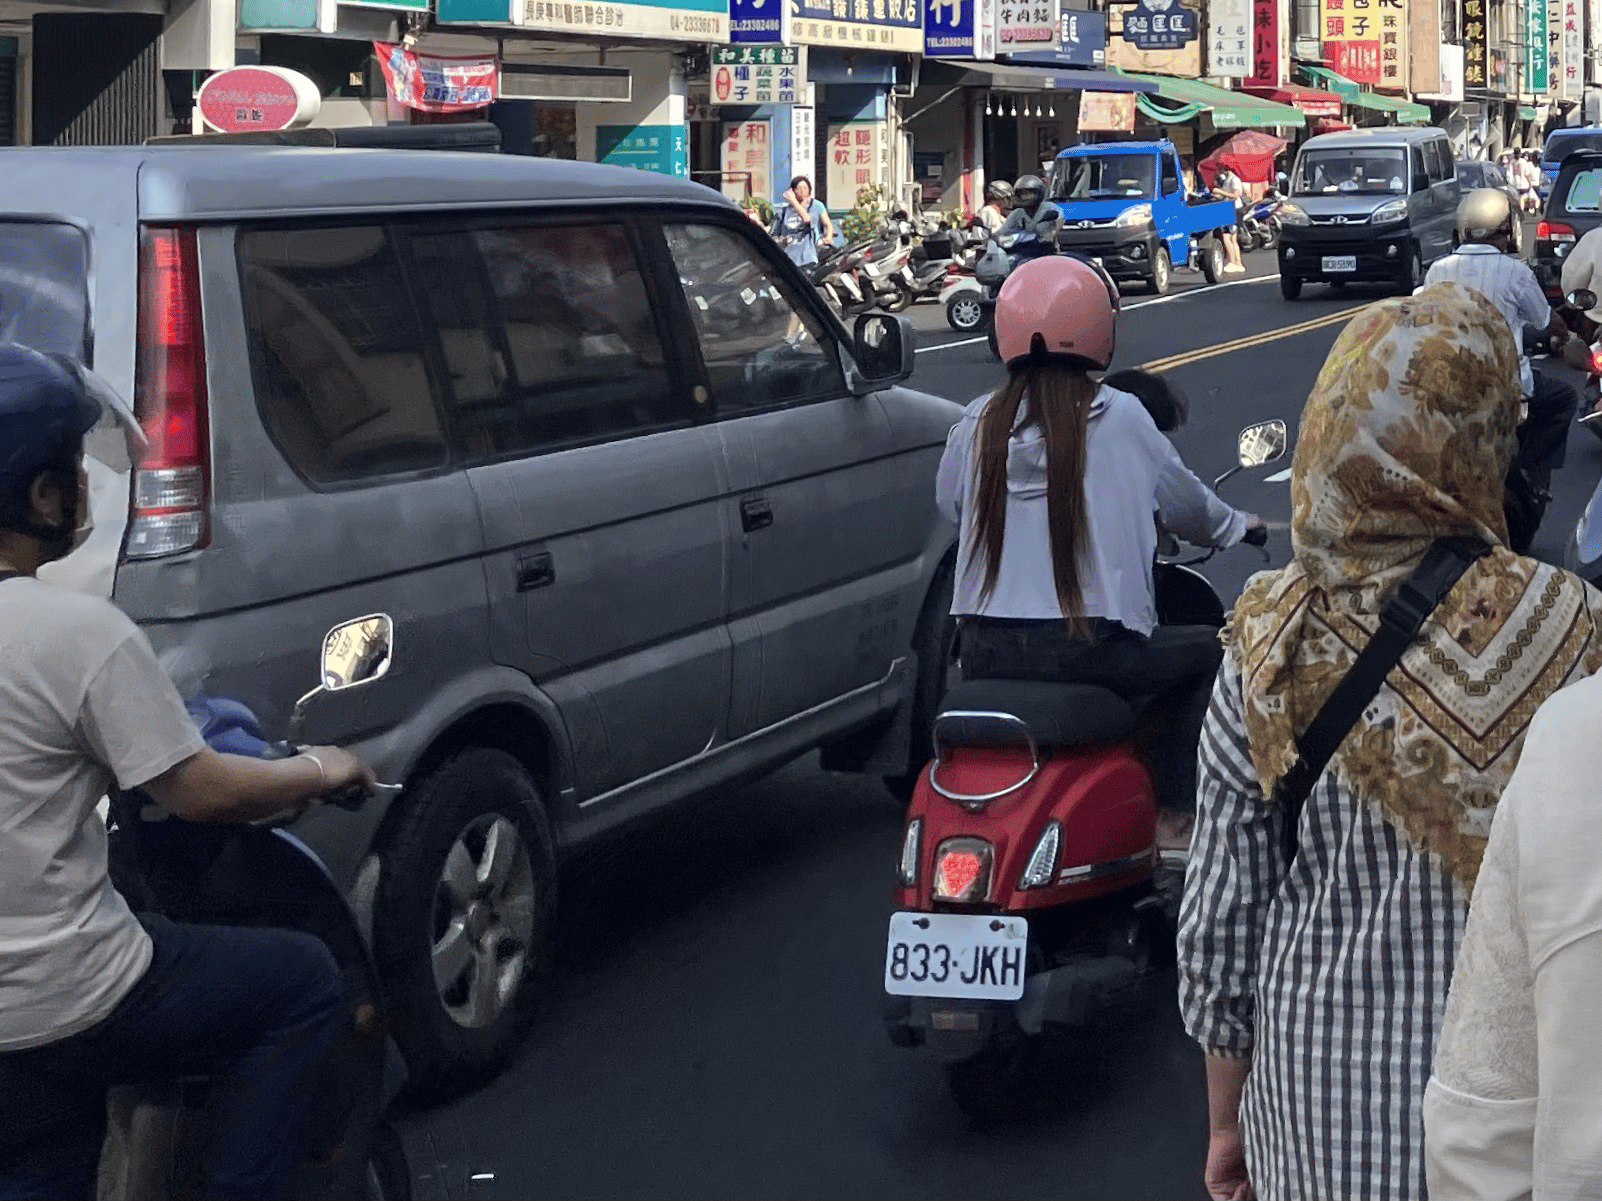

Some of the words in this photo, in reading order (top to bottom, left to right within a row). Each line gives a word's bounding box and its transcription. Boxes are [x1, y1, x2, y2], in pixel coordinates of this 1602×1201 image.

[1001, 7, 1050, 24] 牛肉麵
[718, 49, 797, 65] 和美種苗
[733, 65, 750, 101] 種子
